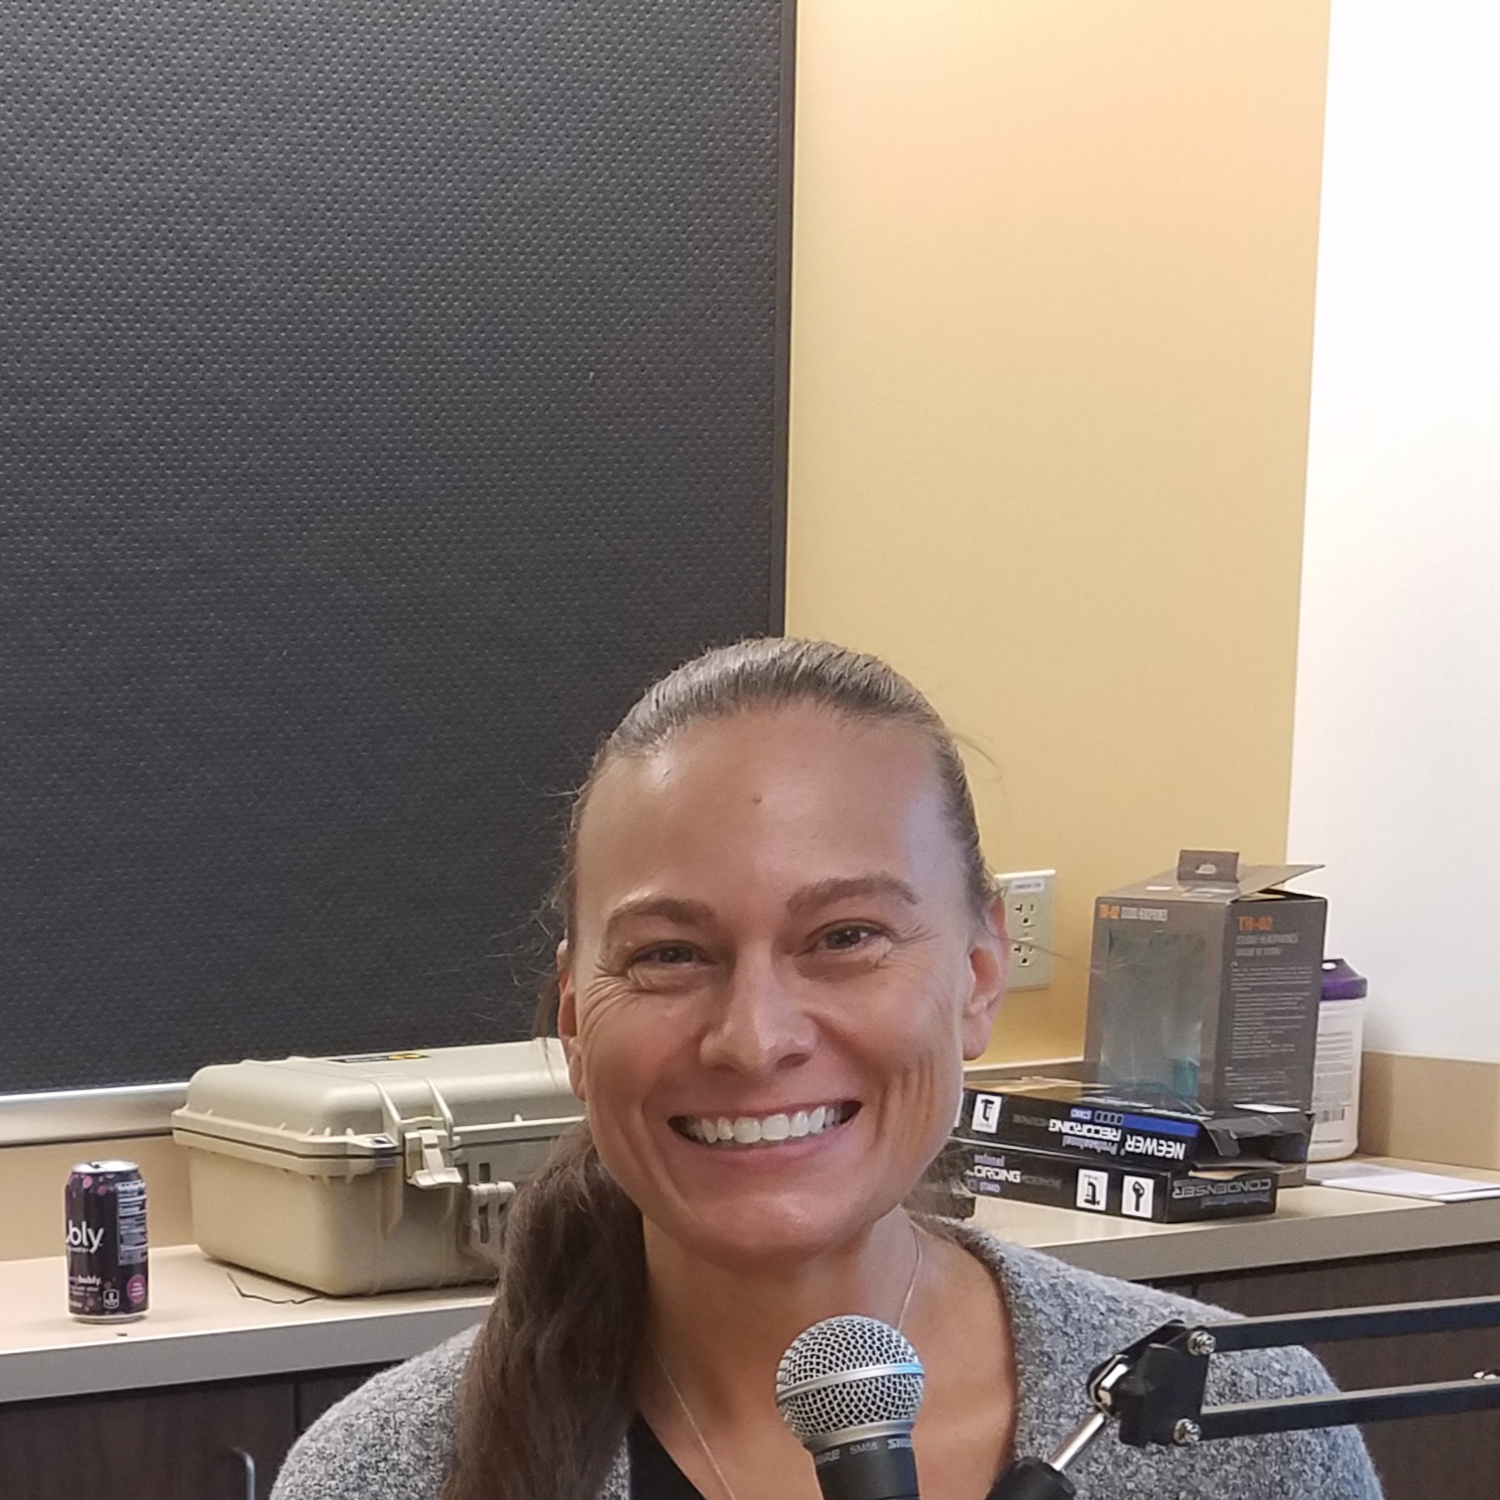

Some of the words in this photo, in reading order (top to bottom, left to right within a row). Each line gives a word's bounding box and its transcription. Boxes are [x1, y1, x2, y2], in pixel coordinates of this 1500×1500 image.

[1048, 1119, 1122, 1141] RECORDING
[1125, 1134, 1186, 1160] NEEWER
[1171, 1178, 1272, 1199] CONDENSER
